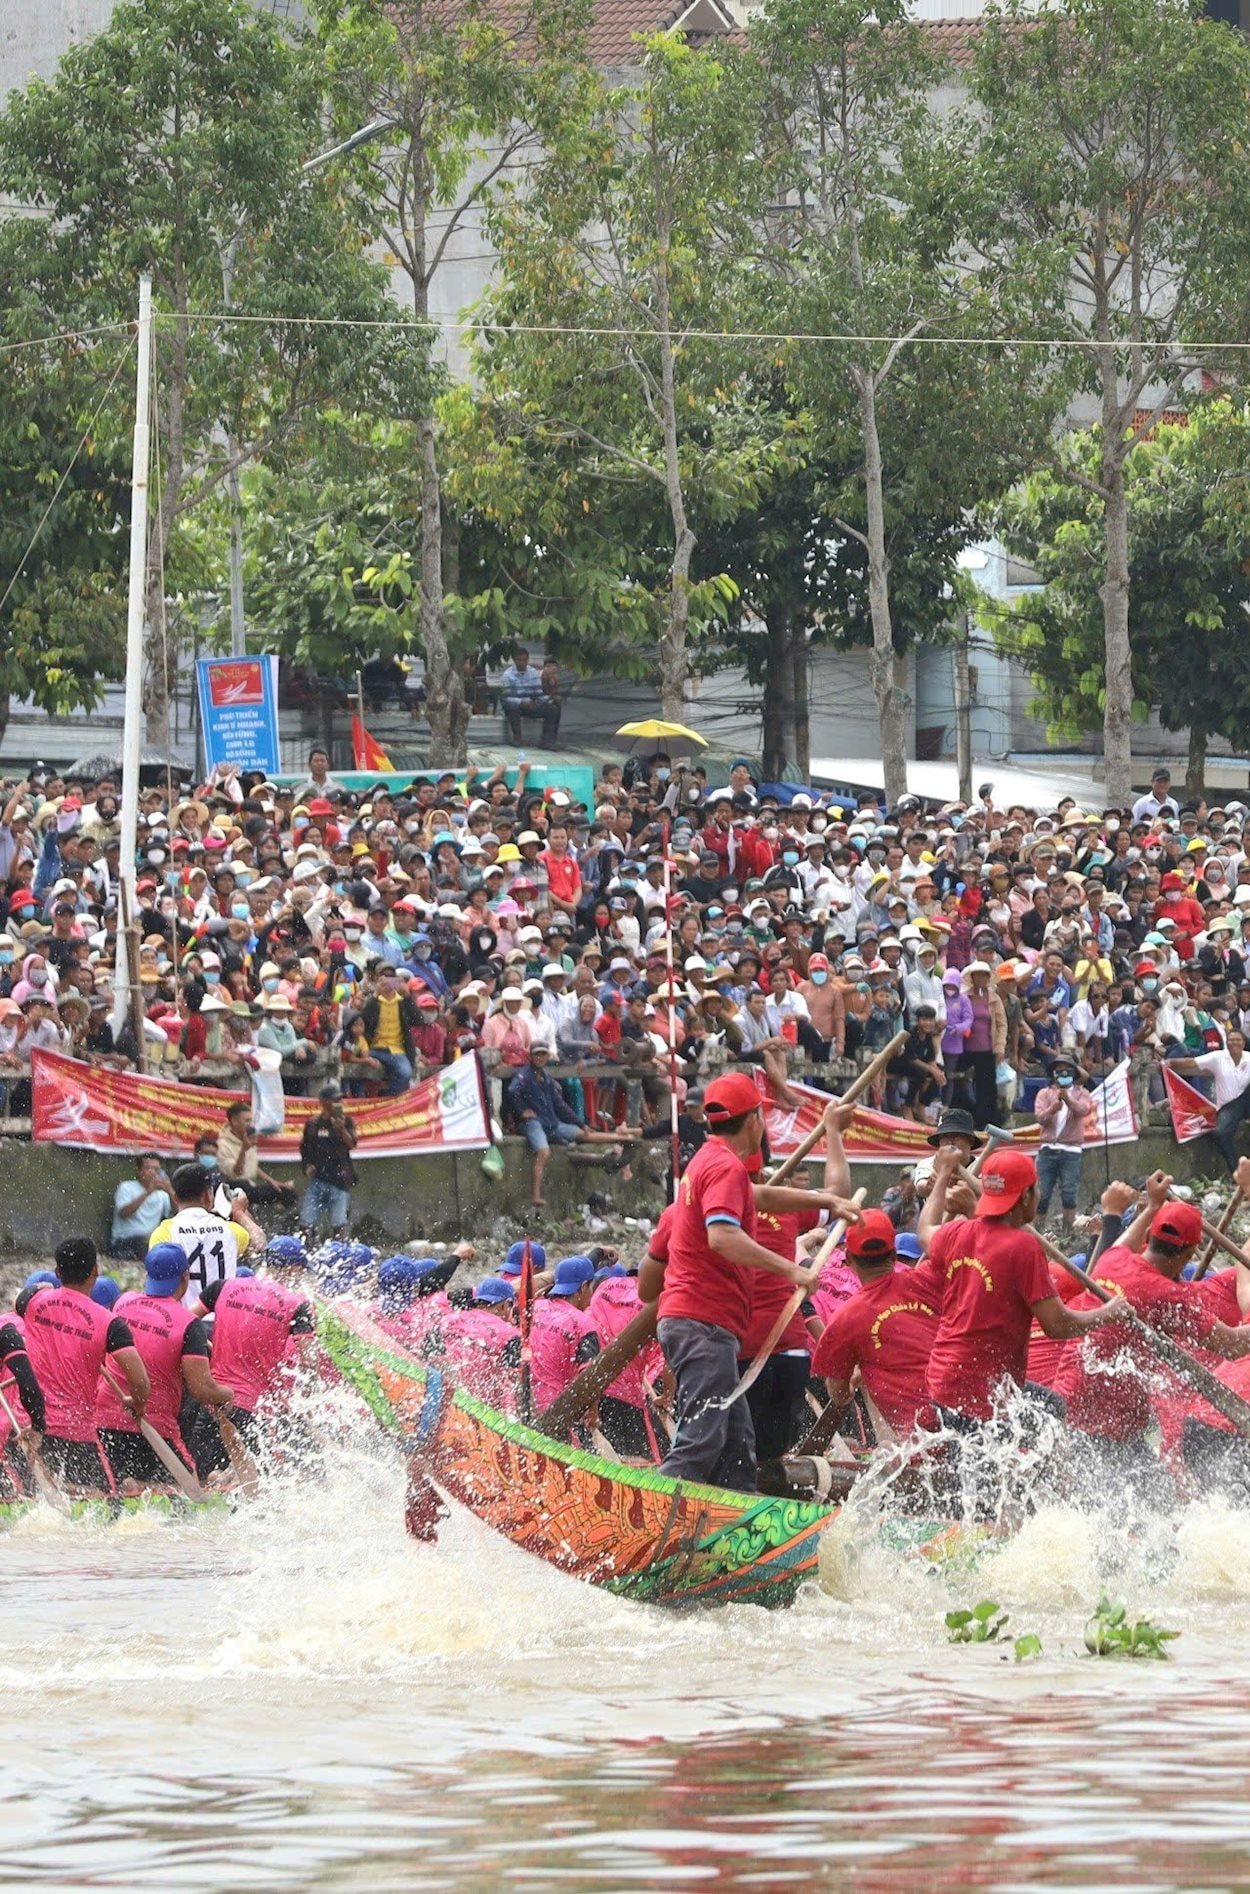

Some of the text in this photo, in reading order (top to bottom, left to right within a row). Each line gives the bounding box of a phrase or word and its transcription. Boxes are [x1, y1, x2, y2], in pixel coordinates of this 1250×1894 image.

[178, 1225, 197, 1234] Anh
[47, 1299, 60, 1307] GHE
[139, 1322, 152, 1333] SÓC
[152, 1326, 170, 1339] TRĂNG
